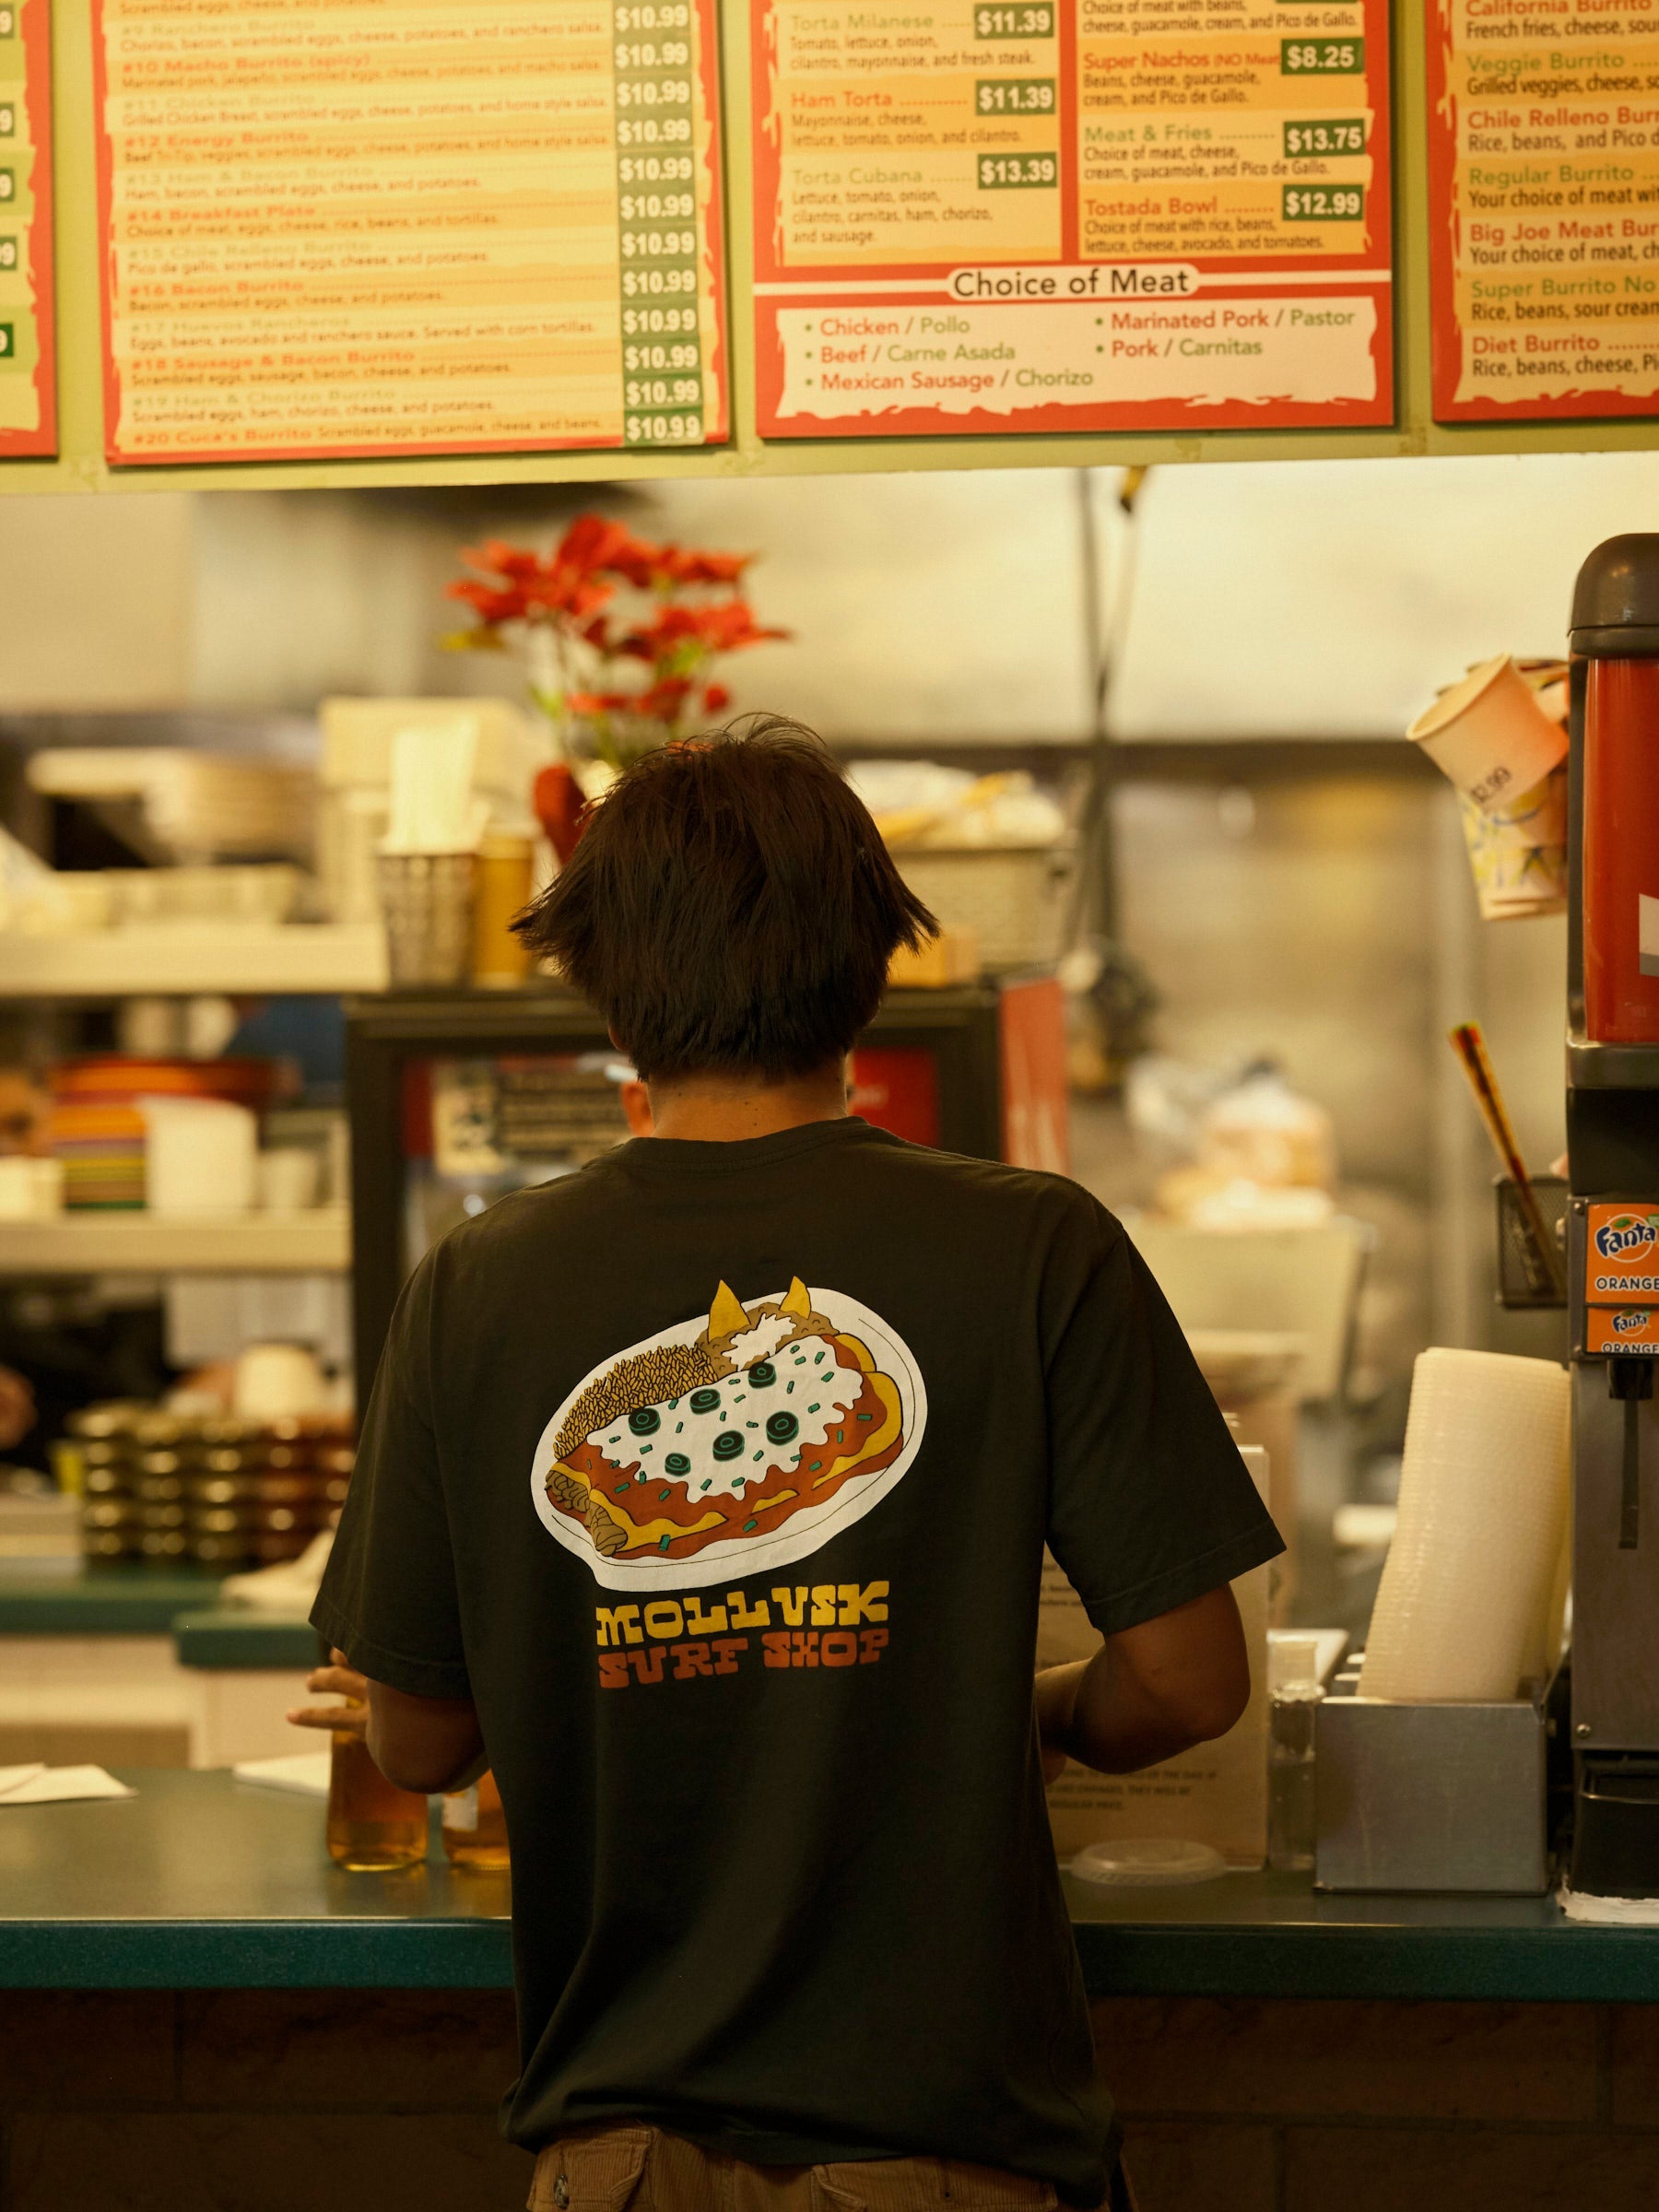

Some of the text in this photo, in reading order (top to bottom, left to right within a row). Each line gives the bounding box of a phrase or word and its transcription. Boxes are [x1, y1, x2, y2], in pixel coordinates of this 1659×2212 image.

[616, 5, 688, 31] $10.99
[1465, 0, 1652, 17] California Burrito
[978, 9, 1051, 36] $11.39
[1465, 17, 1624, 39] French fries, cheese,
[616, 42, 688, 68] $10.99
[1083, 53, 1136, 73] Super
[1141, 50, 1210, 68] Nachos
[1288, 45, 1355, 70] $8.25
[1466, 52, 1624, 74] Veggie Burrito
[618, 80, 689, 107] $10.99
[790, 85, 1053, 112] Ham Torta $11.39
[1467, 107, 1608, 129] Chile Relleno
[618, 119, 690, 145] $10.99
[1084, 124, 1362, 154] Meat & Fries $13.75
[1467, 129, 1646, 153] Rice, beans, and Pico
[619, 157, 693, 183] $10.99
[793, 159, 1055, 185] Torta Cubana $13.39
[1468, 163, 1634, 191] Regular Burrito
[620, 194, 694, 220] $10.99
[1087, 191, 1360, 217] Tostada Bowl $12.99
[1469, 187, 1632, 208] Your choice of meat
[622, 230, 695, 257] $10.99
[1469, 220, 1613, 245] Big Joe Meat
[1470, 242, 1638, 265] Your choice of meat,
[624, 270, 696, 296] $10.99
[953, 267, 1188, 297] Choice of Meat
[1471, 276, 1655, 300] Super Burrito No
[624, 309, 697, 335] $10.99
[1111, 312, 1217, 329] Marinated
[1222, 310, 1268, 327] Pork
[1289, 309, 1353, 325] Pastor
[1471, 300, 1610, 323] Rice, beans, sour
[819, 318, 900, 335] Chicken
[920, 316, 970, 334] Pollo
[820, 345, 867, 363] Beef
[887, 345, 947, 361] Carne
[954, 343, 1016, 360] Asada
[1111, 339, 1158, 357] Pork
[1179, 337, 1263, 356] Carnitas
[1472, 333, 1599, 354] Diet Burrito
[626, 345, 698, 371] $10.99
[1472, 355, 1638, 378] Rice, beans, cheese,
[627, 380, 700, 406] $10.99
[820, 372, 904, 390] Mexican
[911, 371, 994, 394] Sausage
[1015, 369, 1093, 387] Chorizo
[627, 416, 700, 441] $10.99
[1595, 1222, 1656, 1258] Fanta
[1596, 1277, 1659, 1290] ORANGE
[1612, 1310, 1648, 1333] Fanta
[599, 1629, 889, 1688] SURF SHOP
